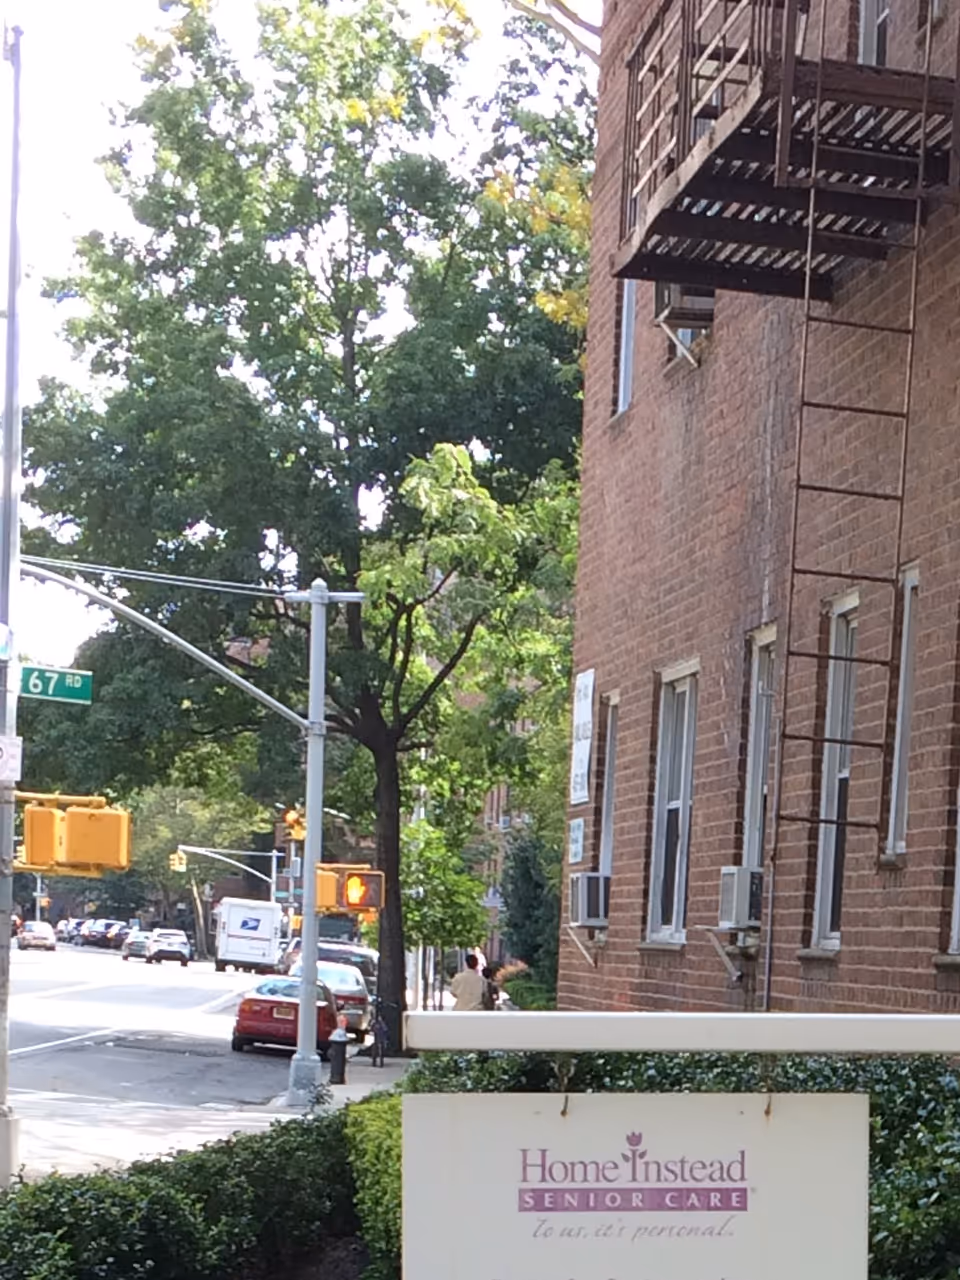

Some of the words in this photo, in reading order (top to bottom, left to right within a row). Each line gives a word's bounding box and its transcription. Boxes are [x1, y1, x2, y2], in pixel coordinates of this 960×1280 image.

[28, 671, 59, 695] 67
[65, 674, 82, 688] RD
[518, 1148, 620, 1184] Home
[620, 1148, 748, 1184] Instead
[523, 1191, 644, 1208] SENIOR
[664, 1191, 742, 1208] CARE
[558, 1225, 589, 1240] us,
[594, 1217, 625, 1240] it's
[632, 1214, 736, 1241] personal.
